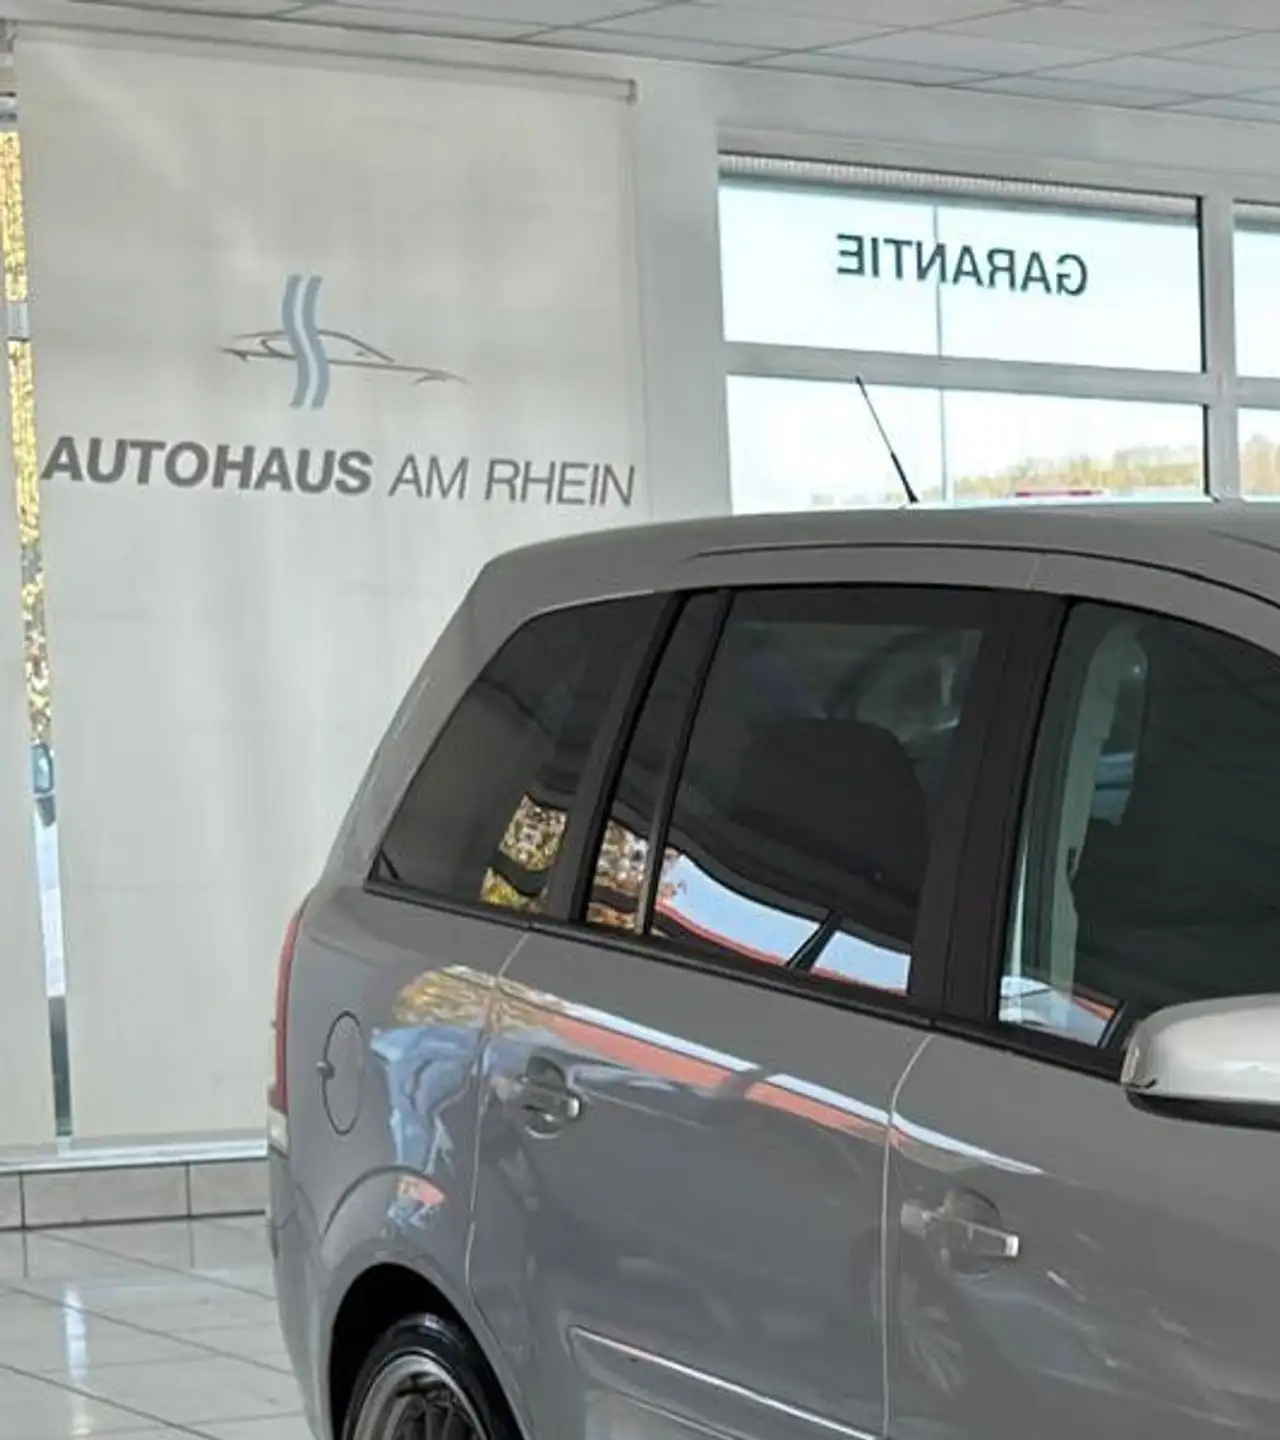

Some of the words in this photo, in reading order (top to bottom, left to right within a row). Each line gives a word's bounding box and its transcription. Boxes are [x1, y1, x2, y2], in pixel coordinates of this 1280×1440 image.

[41, 436, 373, 496] AUTOHAUS
[388, 453, 469, 500] AM
[484, 458, 636, 507] RHEIN
